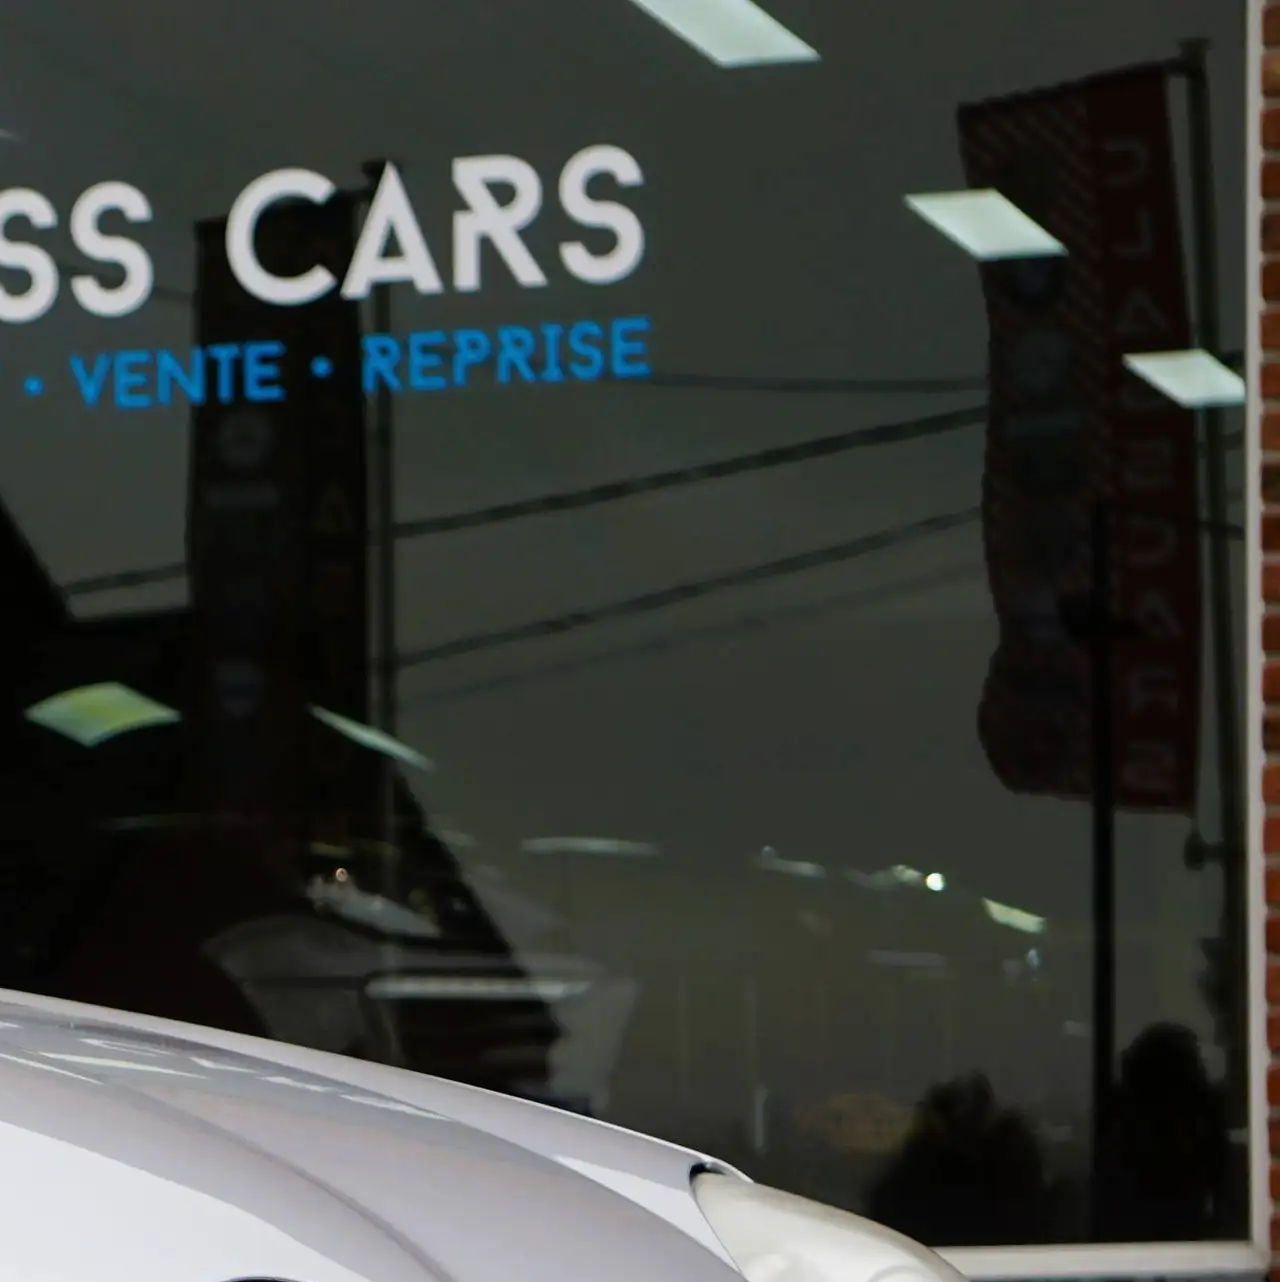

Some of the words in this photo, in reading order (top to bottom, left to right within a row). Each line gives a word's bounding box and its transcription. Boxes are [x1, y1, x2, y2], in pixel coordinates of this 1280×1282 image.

[225, 144, 647, 306] CARS
[68, 340, 285, 411] VENTE
[361, 315, 653, 394] REPRISE
